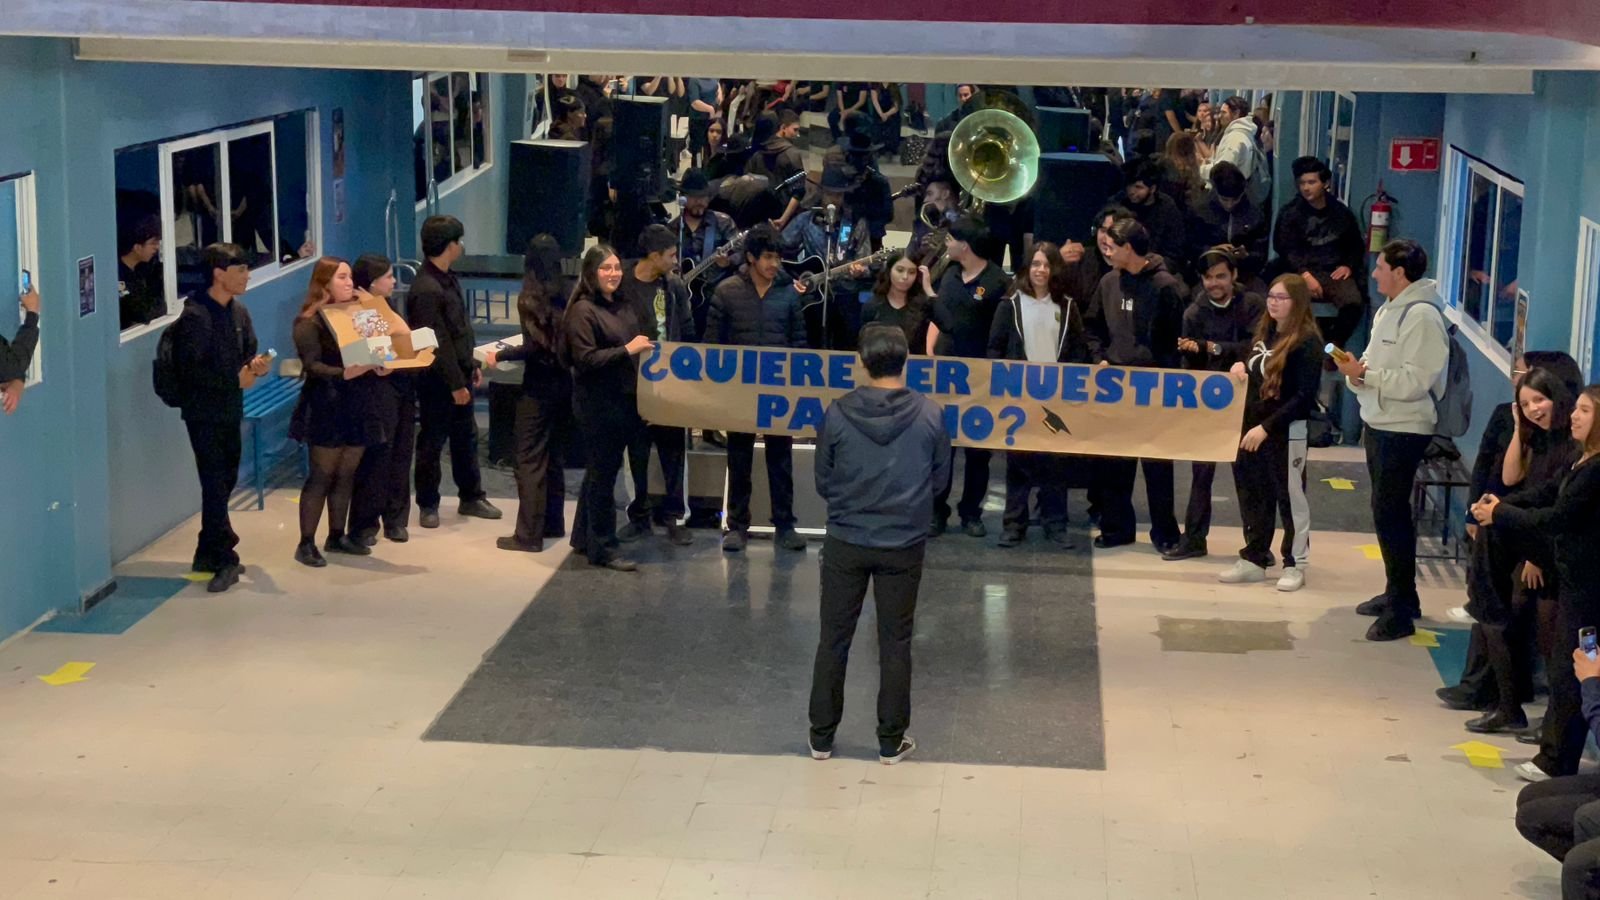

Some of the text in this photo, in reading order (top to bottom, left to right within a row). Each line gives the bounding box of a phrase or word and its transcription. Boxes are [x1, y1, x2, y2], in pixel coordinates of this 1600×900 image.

[641, 342, 1234, 410] ¿QUIERE ER NUESTRO
